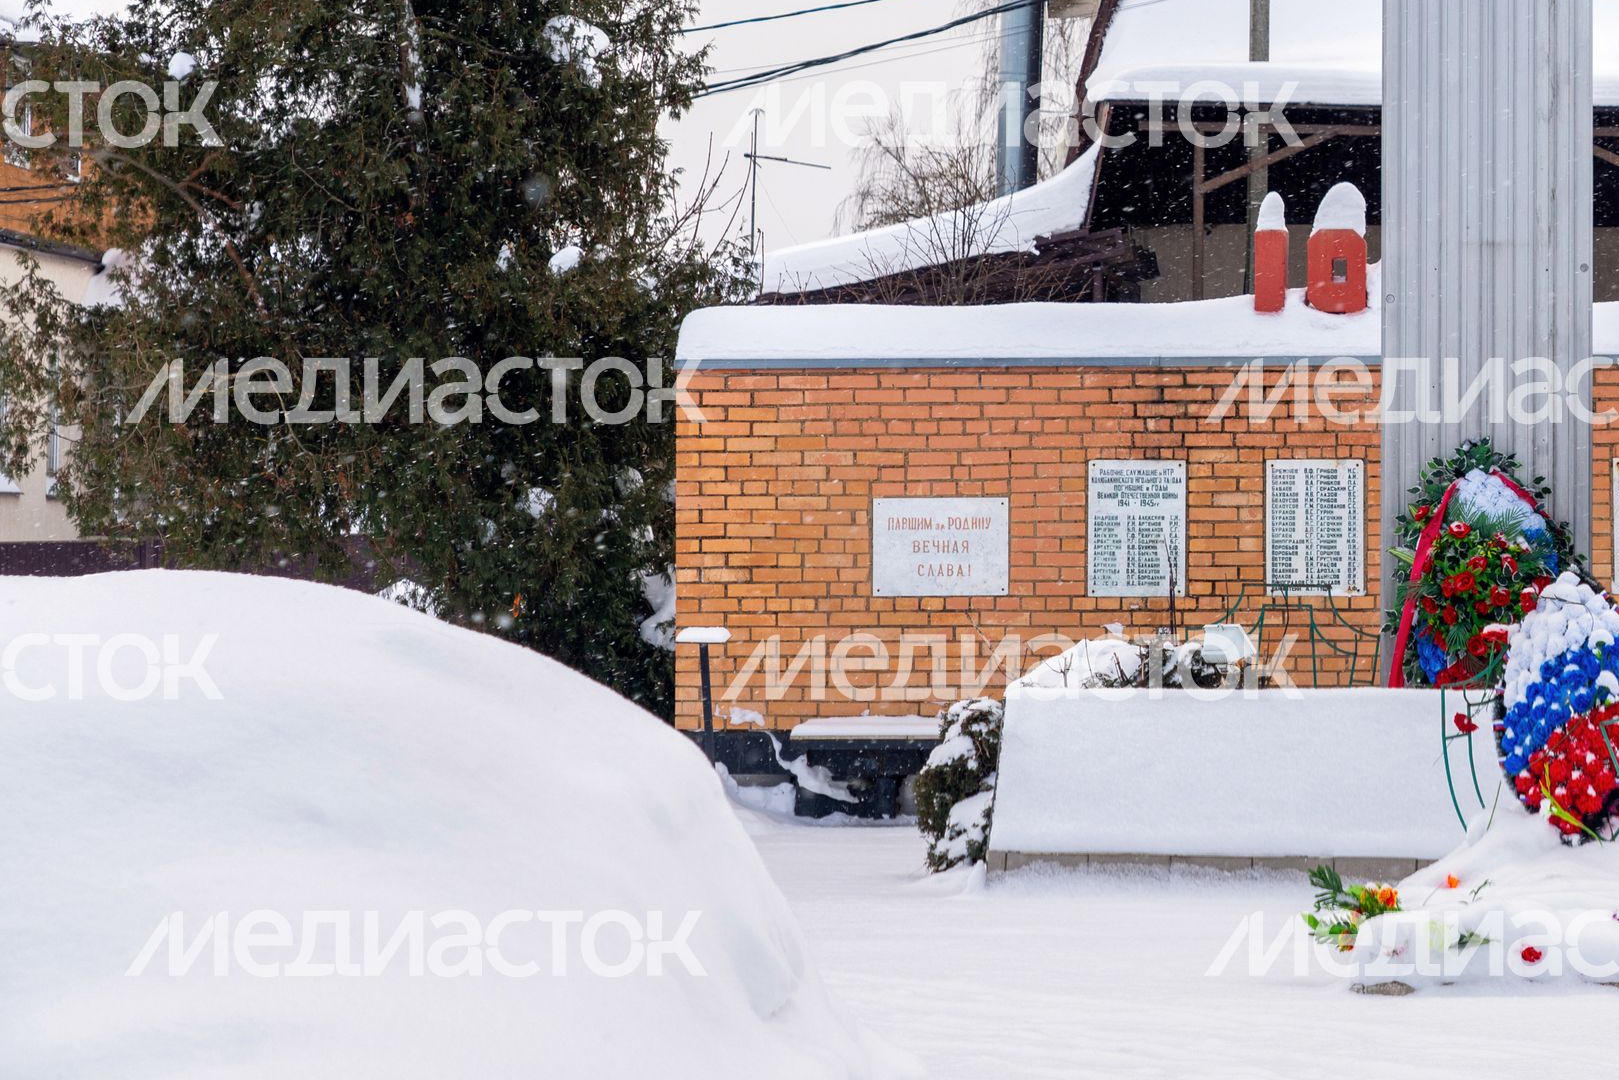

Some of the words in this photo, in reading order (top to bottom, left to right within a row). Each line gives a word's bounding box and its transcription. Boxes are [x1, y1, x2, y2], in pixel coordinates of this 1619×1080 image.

[888, 517, 932, 530] ПАВШИМ
[948, 517, 991, 530] РОДИНУ
[912, 540, 969, 553] ВЕЧНАЯ
[918, 563, 971, 577] СЛАВА!
